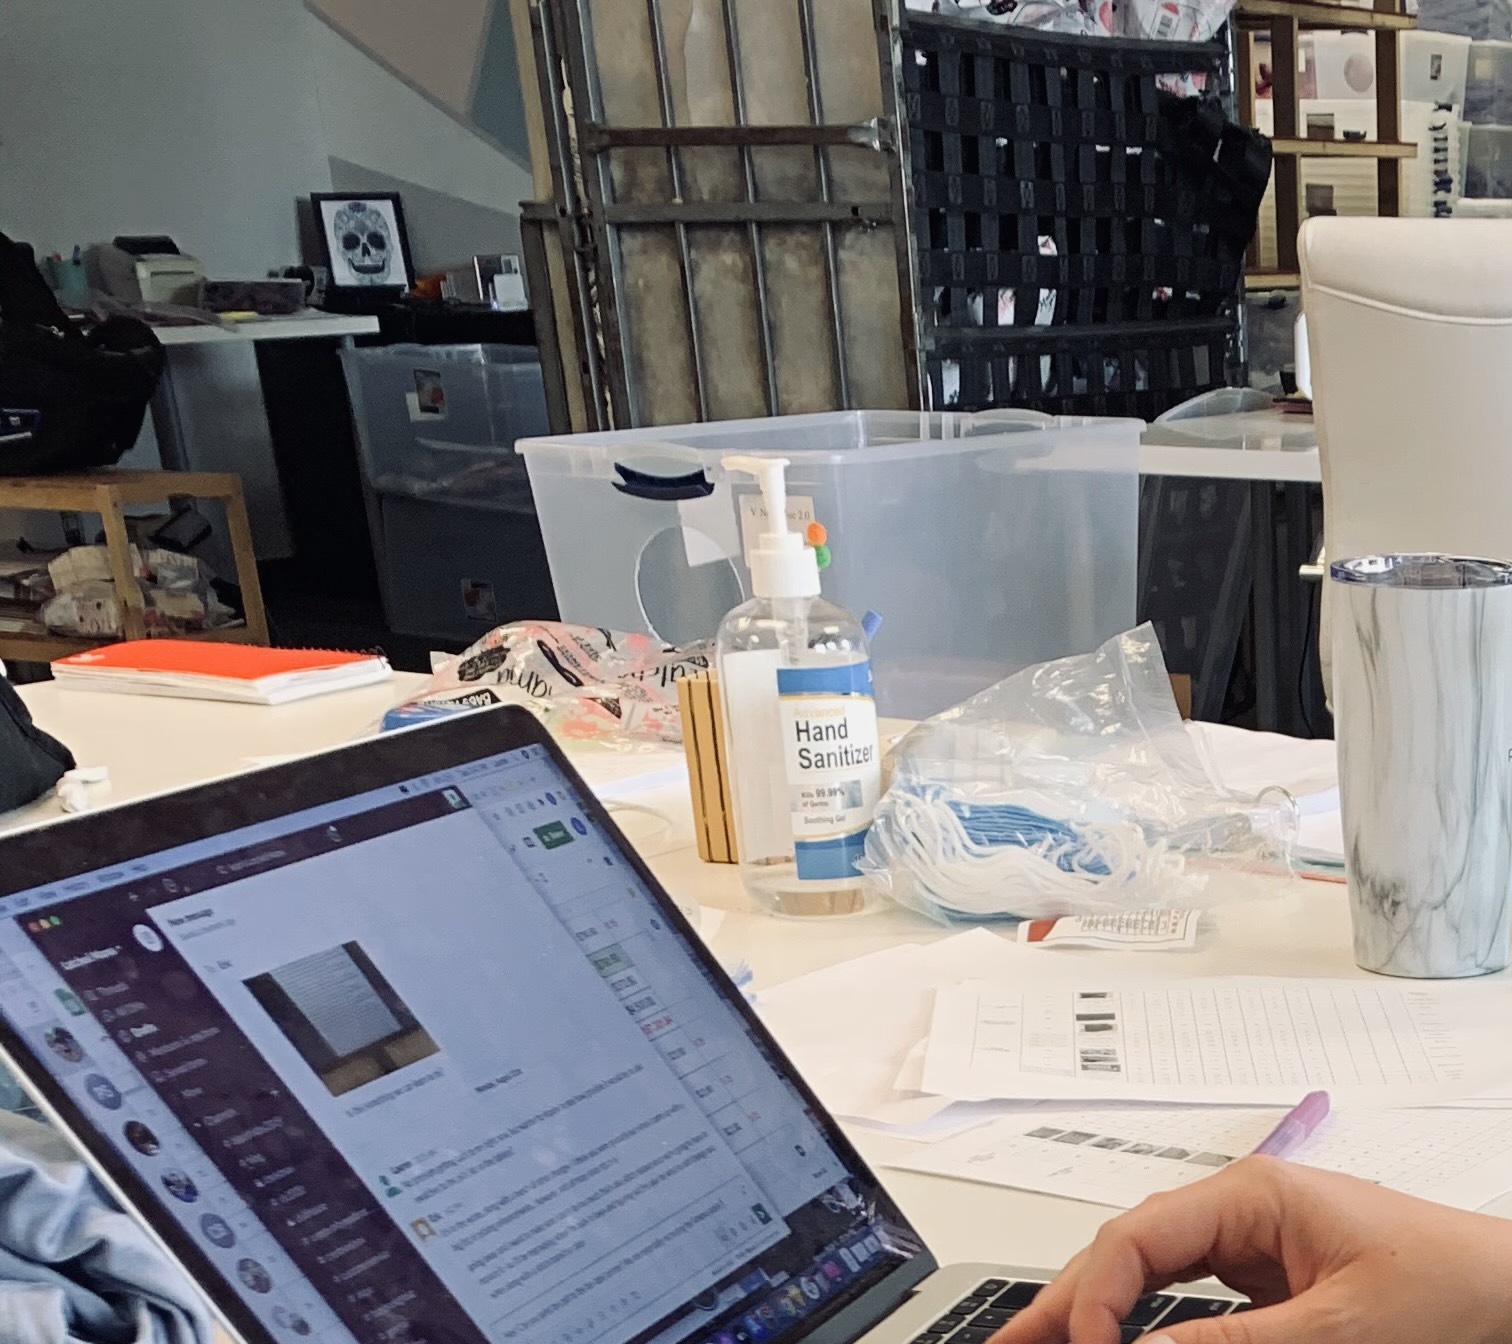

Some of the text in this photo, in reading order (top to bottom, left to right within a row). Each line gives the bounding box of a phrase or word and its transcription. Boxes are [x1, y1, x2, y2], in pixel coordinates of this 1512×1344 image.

[795, 717, 849, 743] Hand
[798, 743, 875, 770] Sanitizer
[815, 787, 846, 799] 99.99%
[803, 814, 835, 826] Soothing
